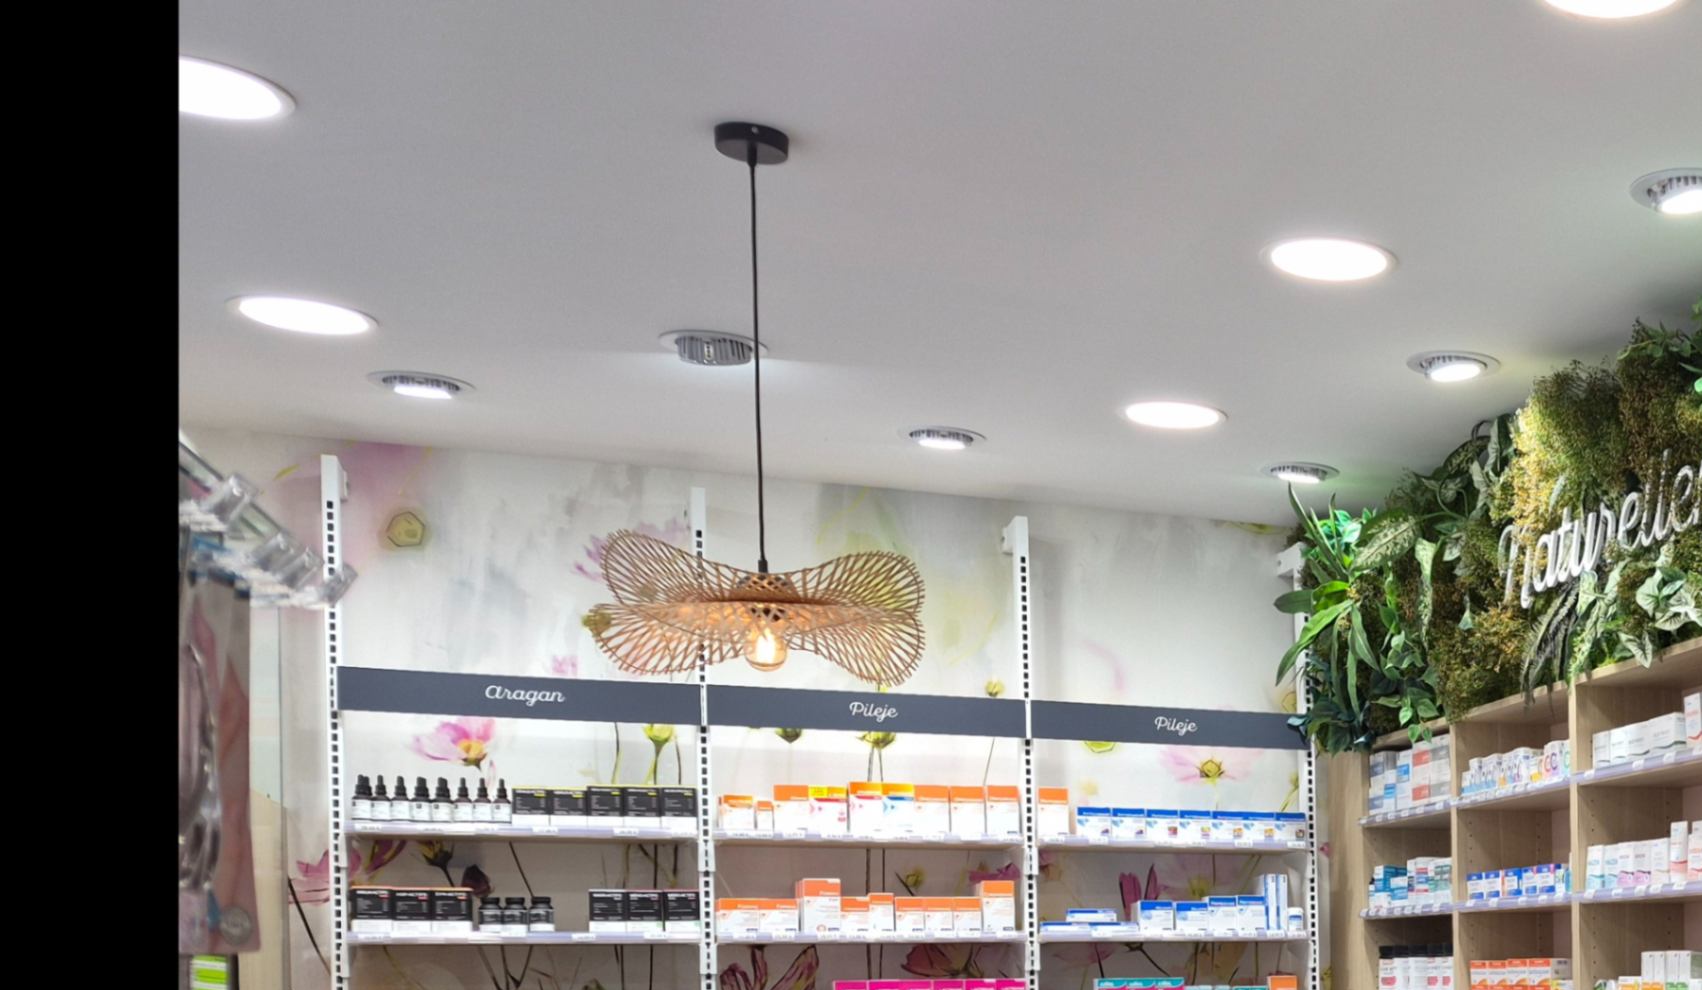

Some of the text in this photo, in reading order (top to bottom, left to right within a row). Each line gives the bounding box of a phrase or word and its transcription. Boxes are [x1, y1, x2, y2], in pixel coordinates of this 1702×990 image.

[485, 685, 565, 706] Aragan
[850, 702, 898, 723] Pileje
[1154, 717, 1197, 736] Pileje
